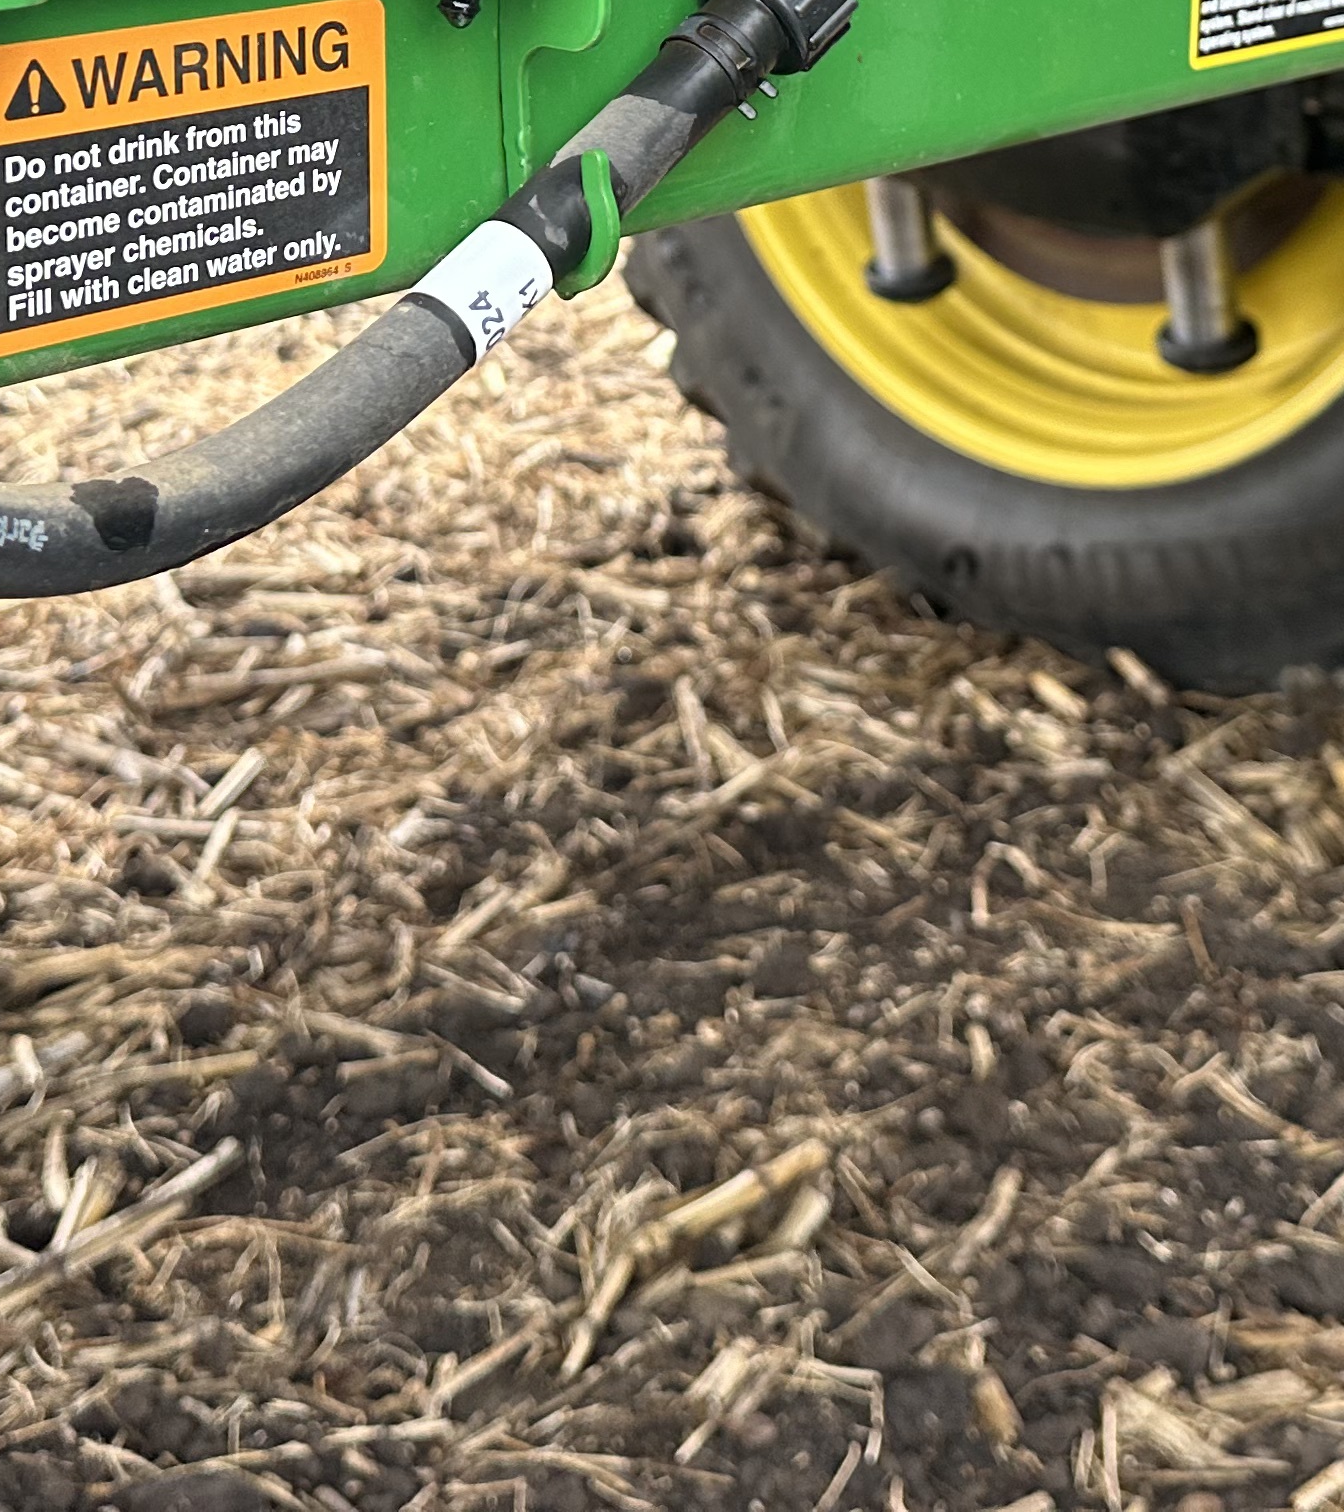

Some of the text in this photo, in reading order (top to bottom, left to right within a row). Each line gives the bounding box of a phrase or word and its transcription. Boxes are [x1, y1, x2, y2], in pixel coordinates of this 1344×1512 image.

[71, 20, 350, 110] WARNING
[4, 111, 301, 183] Do not drink from this
[5, 139, 339, 217] container. Container may
[6, 168, 342, 252] become contaminated by
[7, 215, 264, 288] sprayer chemicals.
[8, 230, 341, 321] Fill with clean water only.
